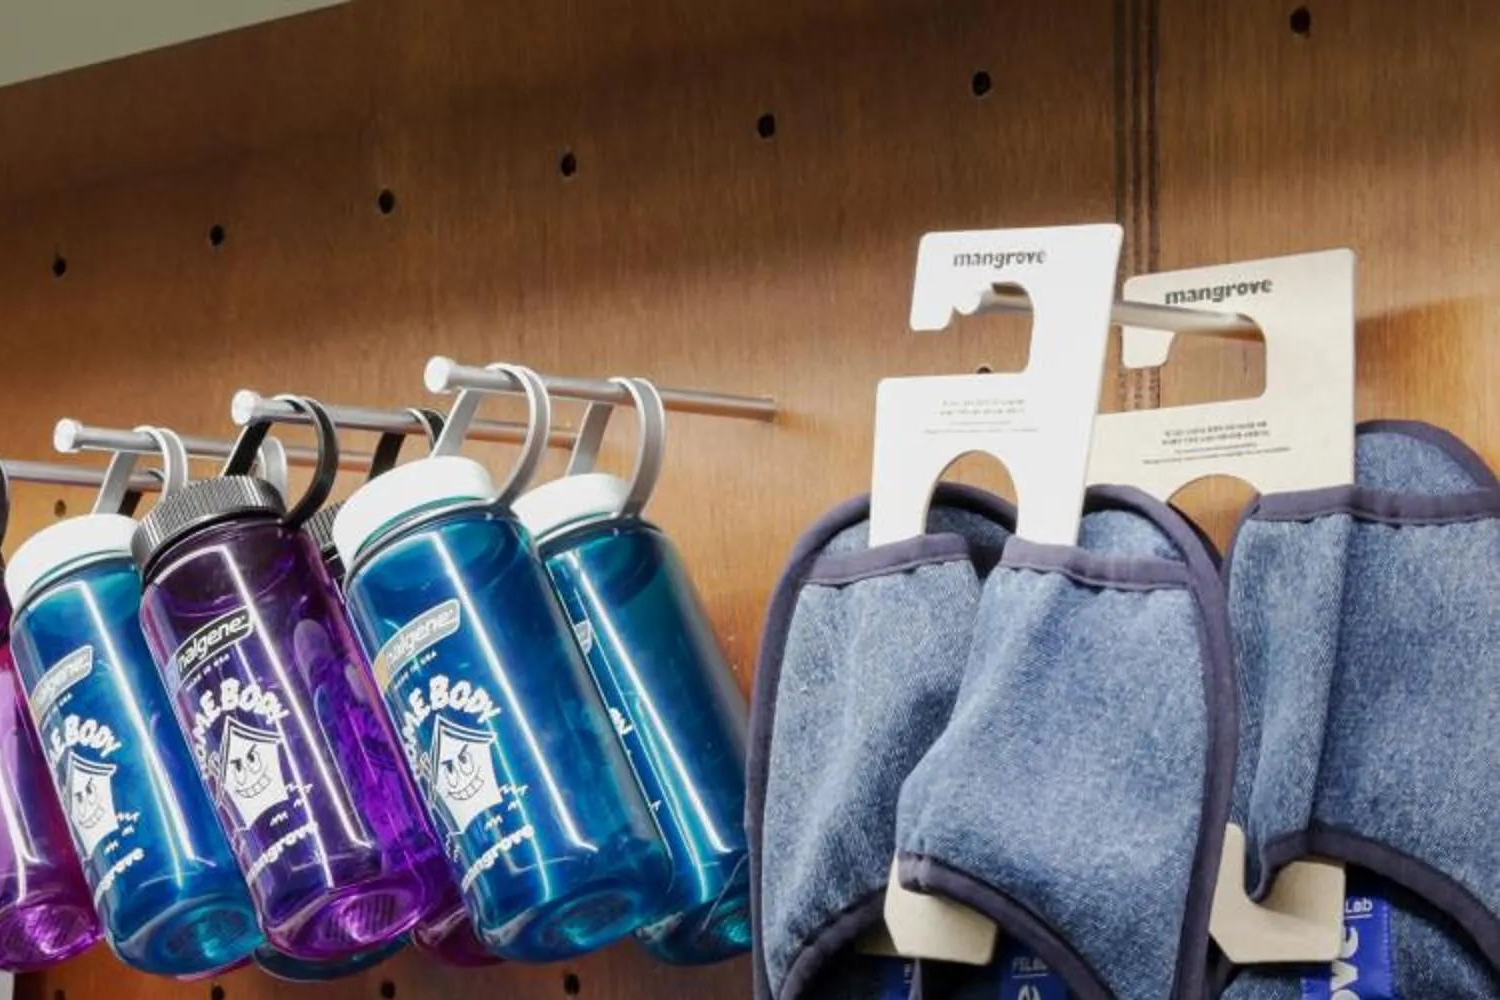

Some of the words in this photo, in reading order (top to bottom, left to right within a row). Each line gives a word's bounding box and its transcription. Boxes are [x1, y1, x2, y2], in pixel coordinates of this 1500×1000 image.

[953, 248, 1047, 270] mangrove
[1164, 276, 1274, 306] mangrove
[178, 615, 246, 673] nalgene
[220, 676, 291, 726] BODY
[429, 674, 502, 725] BODY
[64, 713, 123, 758] BODY
